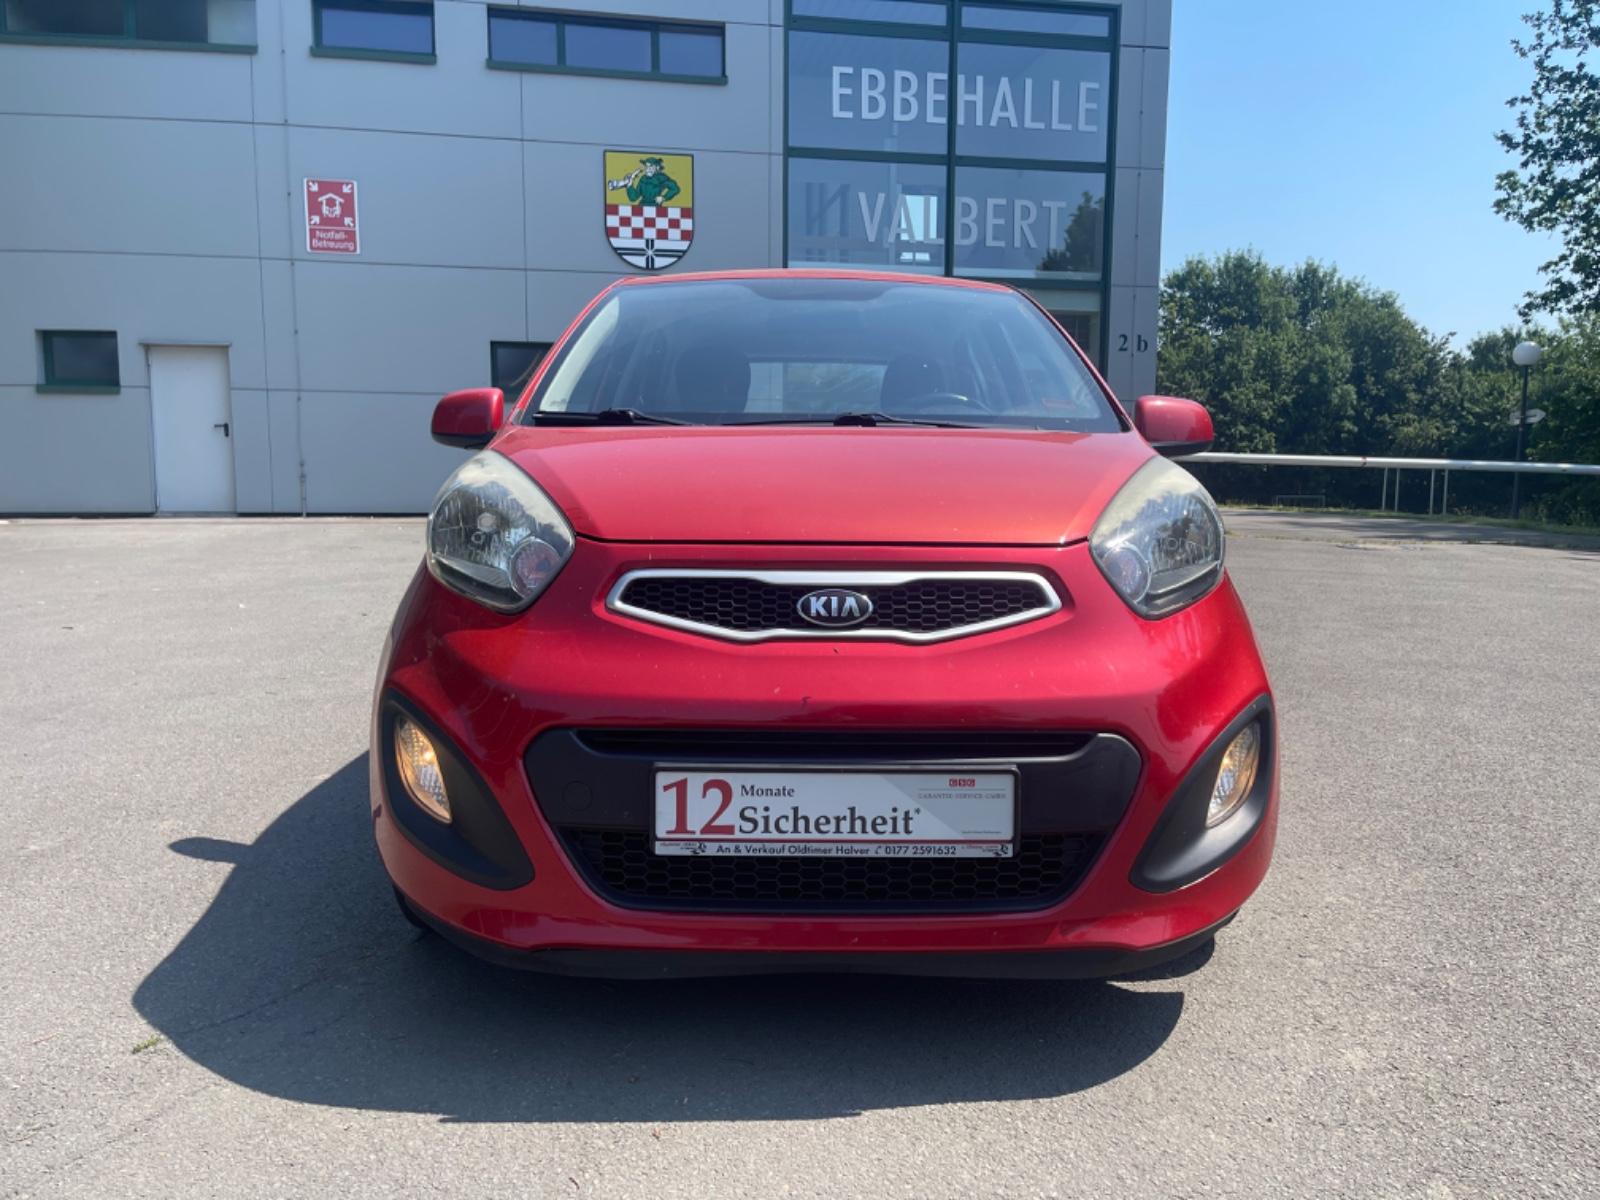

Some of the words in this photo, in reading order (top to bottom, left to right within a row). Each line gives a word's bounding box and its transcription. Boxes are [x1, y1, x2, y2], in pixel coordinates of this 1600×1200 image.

[831, 65, 1100, 133] EBBEHALLE
[857, 191, 1067, 249] VALBERT
[809, 596, 860, 617] KIA
[662, 777, 736, 836] 12
[740, 784, 796, 798] Monate
[716, 845, 731, 855] An
[734, 845, 742, 855] &
[744, 844, 785, 855] Verkauf
[787, 845, 832, 855] Oldtimer
[836, 845, 869, 856] Halver
[884, 845, 908, 856] 0177
[912, 845, 957, 856] 2591632
